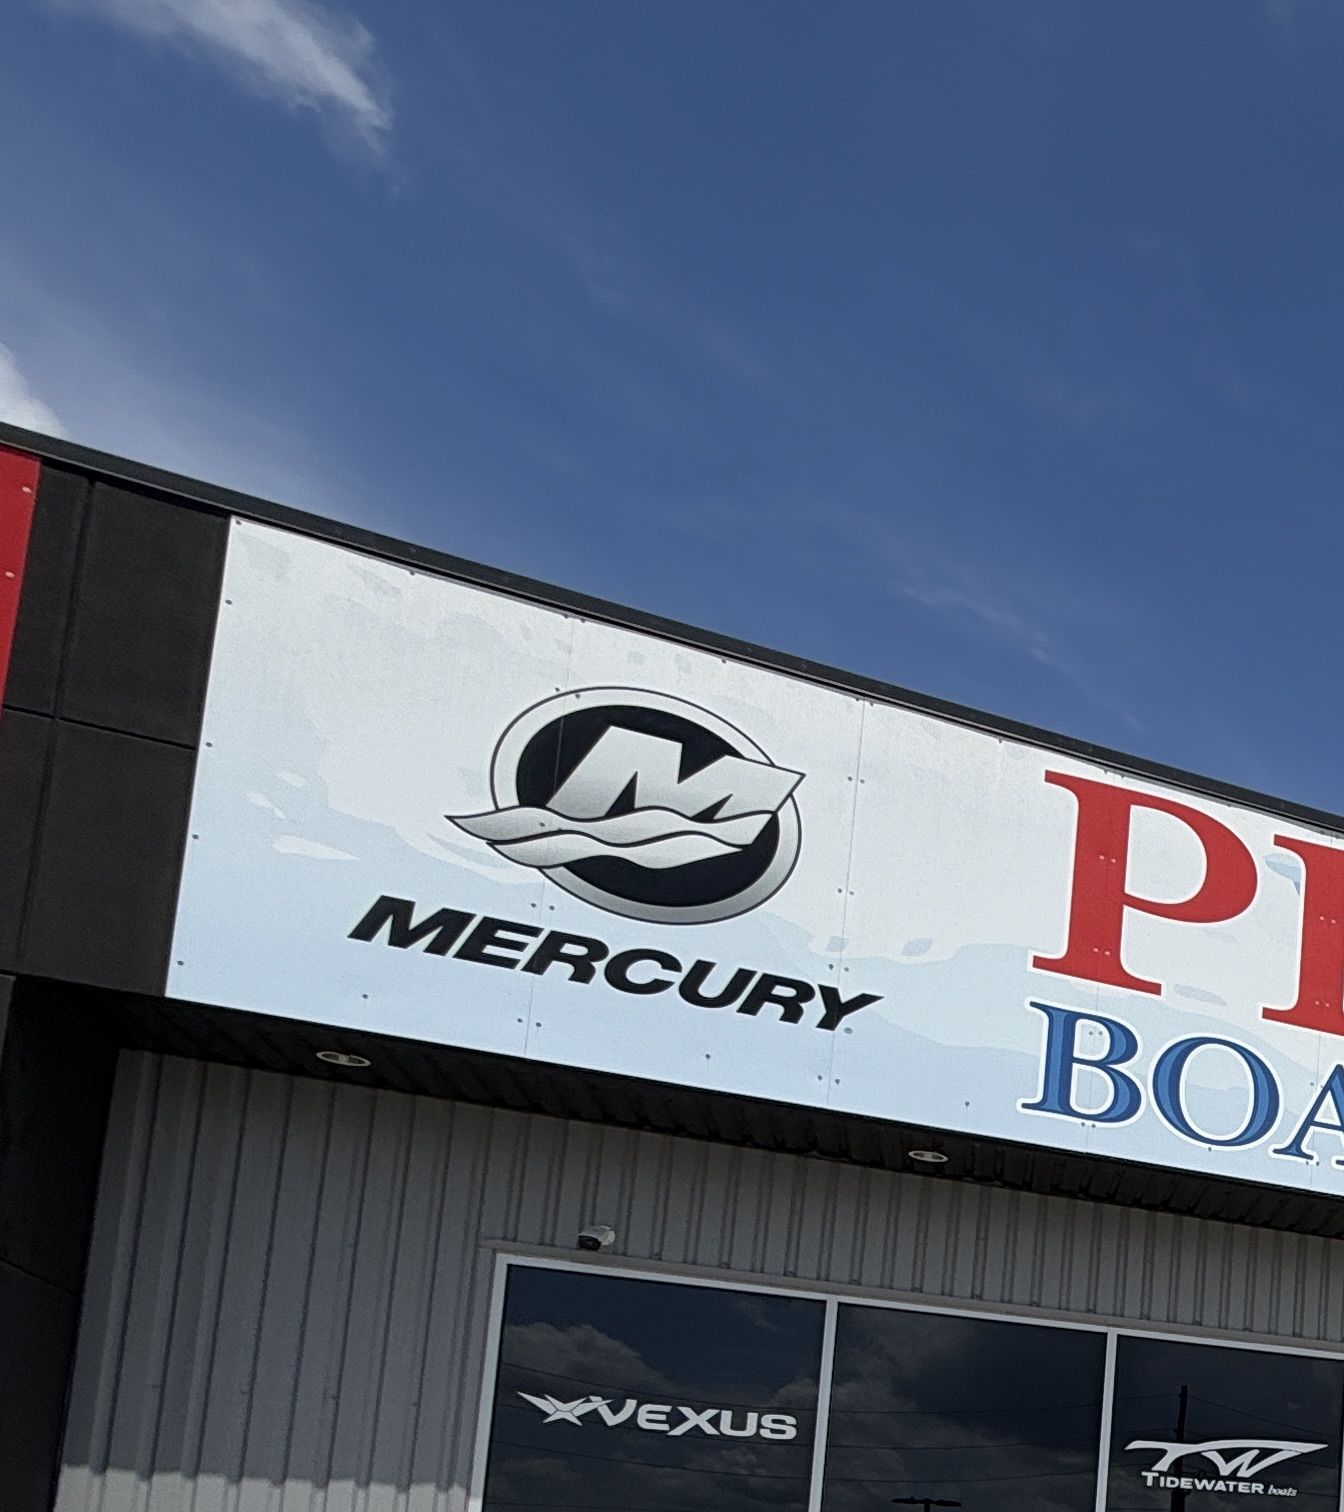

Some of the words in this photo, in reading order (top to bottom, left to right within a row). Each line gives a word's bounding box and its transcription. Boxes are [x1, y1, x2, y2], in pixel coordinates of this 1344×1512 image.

[348, 895, 885, 1032] MERCURY
[589, 1395, 798, 1440] VEXUS
[1141, 1471, 1265, 1495] TIDEWATER
[1267, 1484, 1298, 1497] boats
